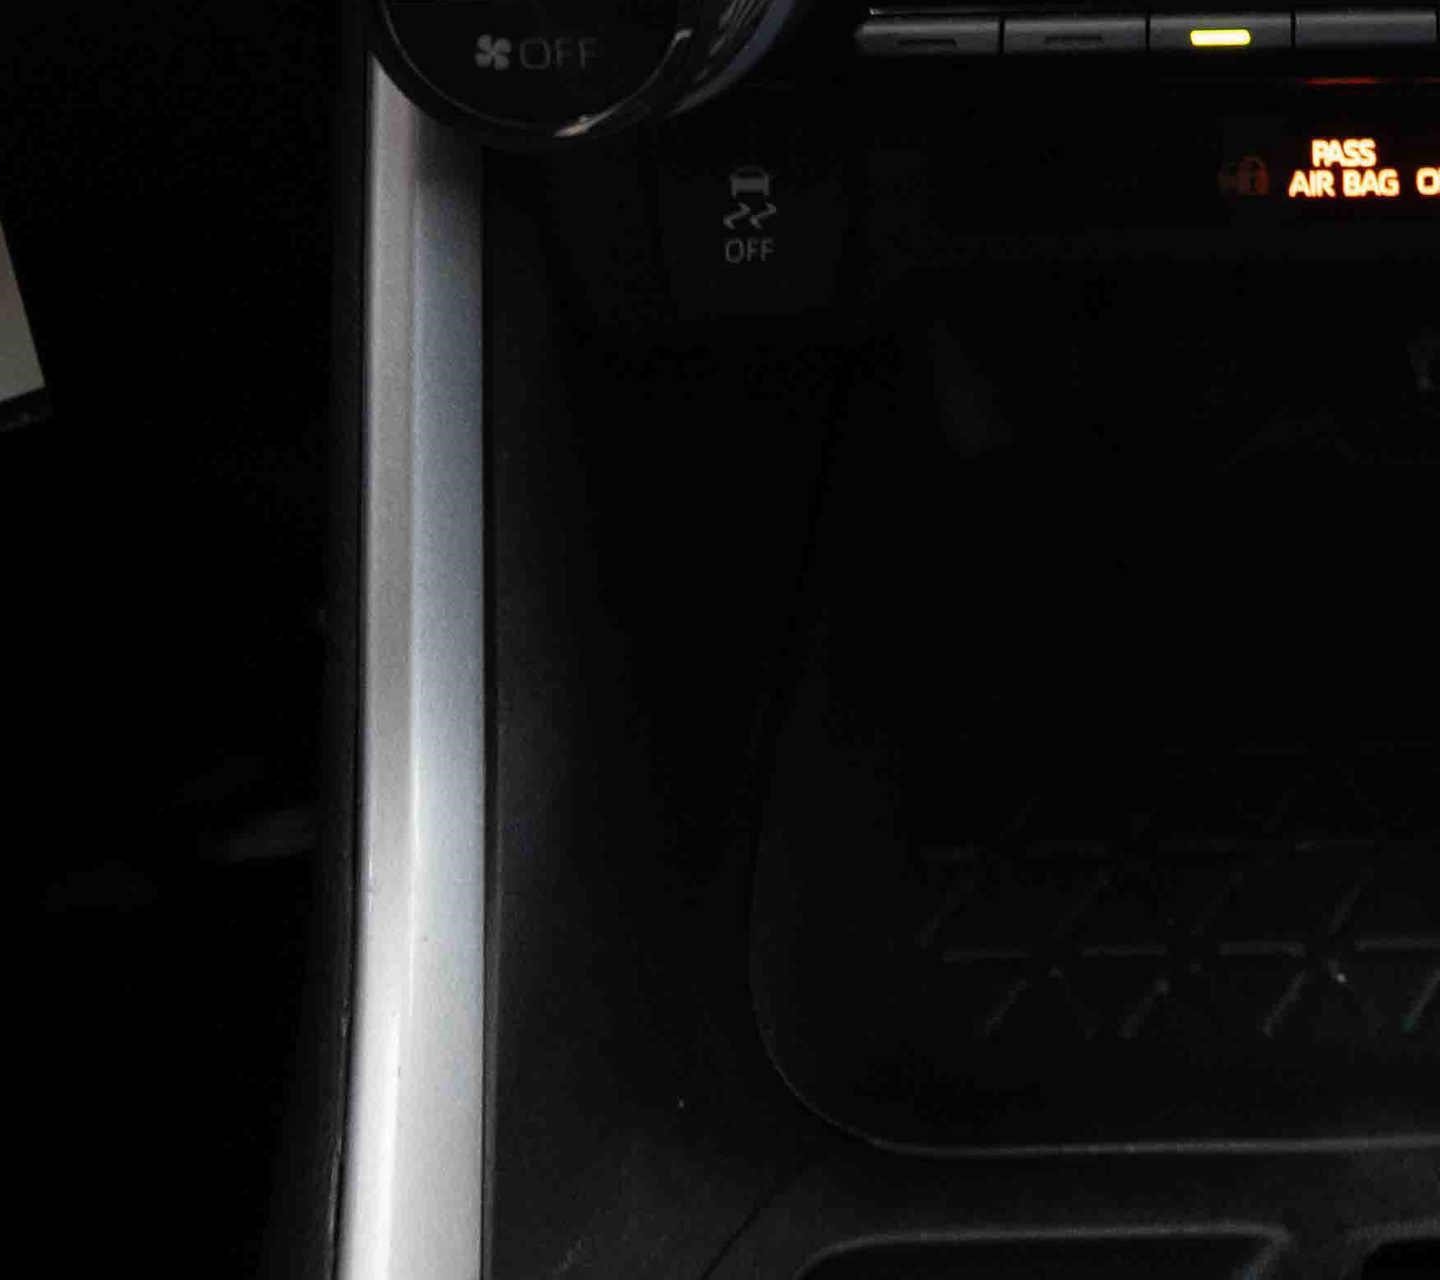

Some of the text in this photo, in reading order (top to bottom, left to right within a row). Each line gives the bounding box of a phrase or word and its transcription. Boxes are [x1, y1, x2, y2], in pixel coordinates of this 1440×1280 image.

[519, 37, 599, 72] OFF
[1311, 137, 1378, 169] PASS
[1288, 169, 1336, 198] AIR
[1342, 168, 1401, 198] BAG
[725, 237, 777, 263] OFF
